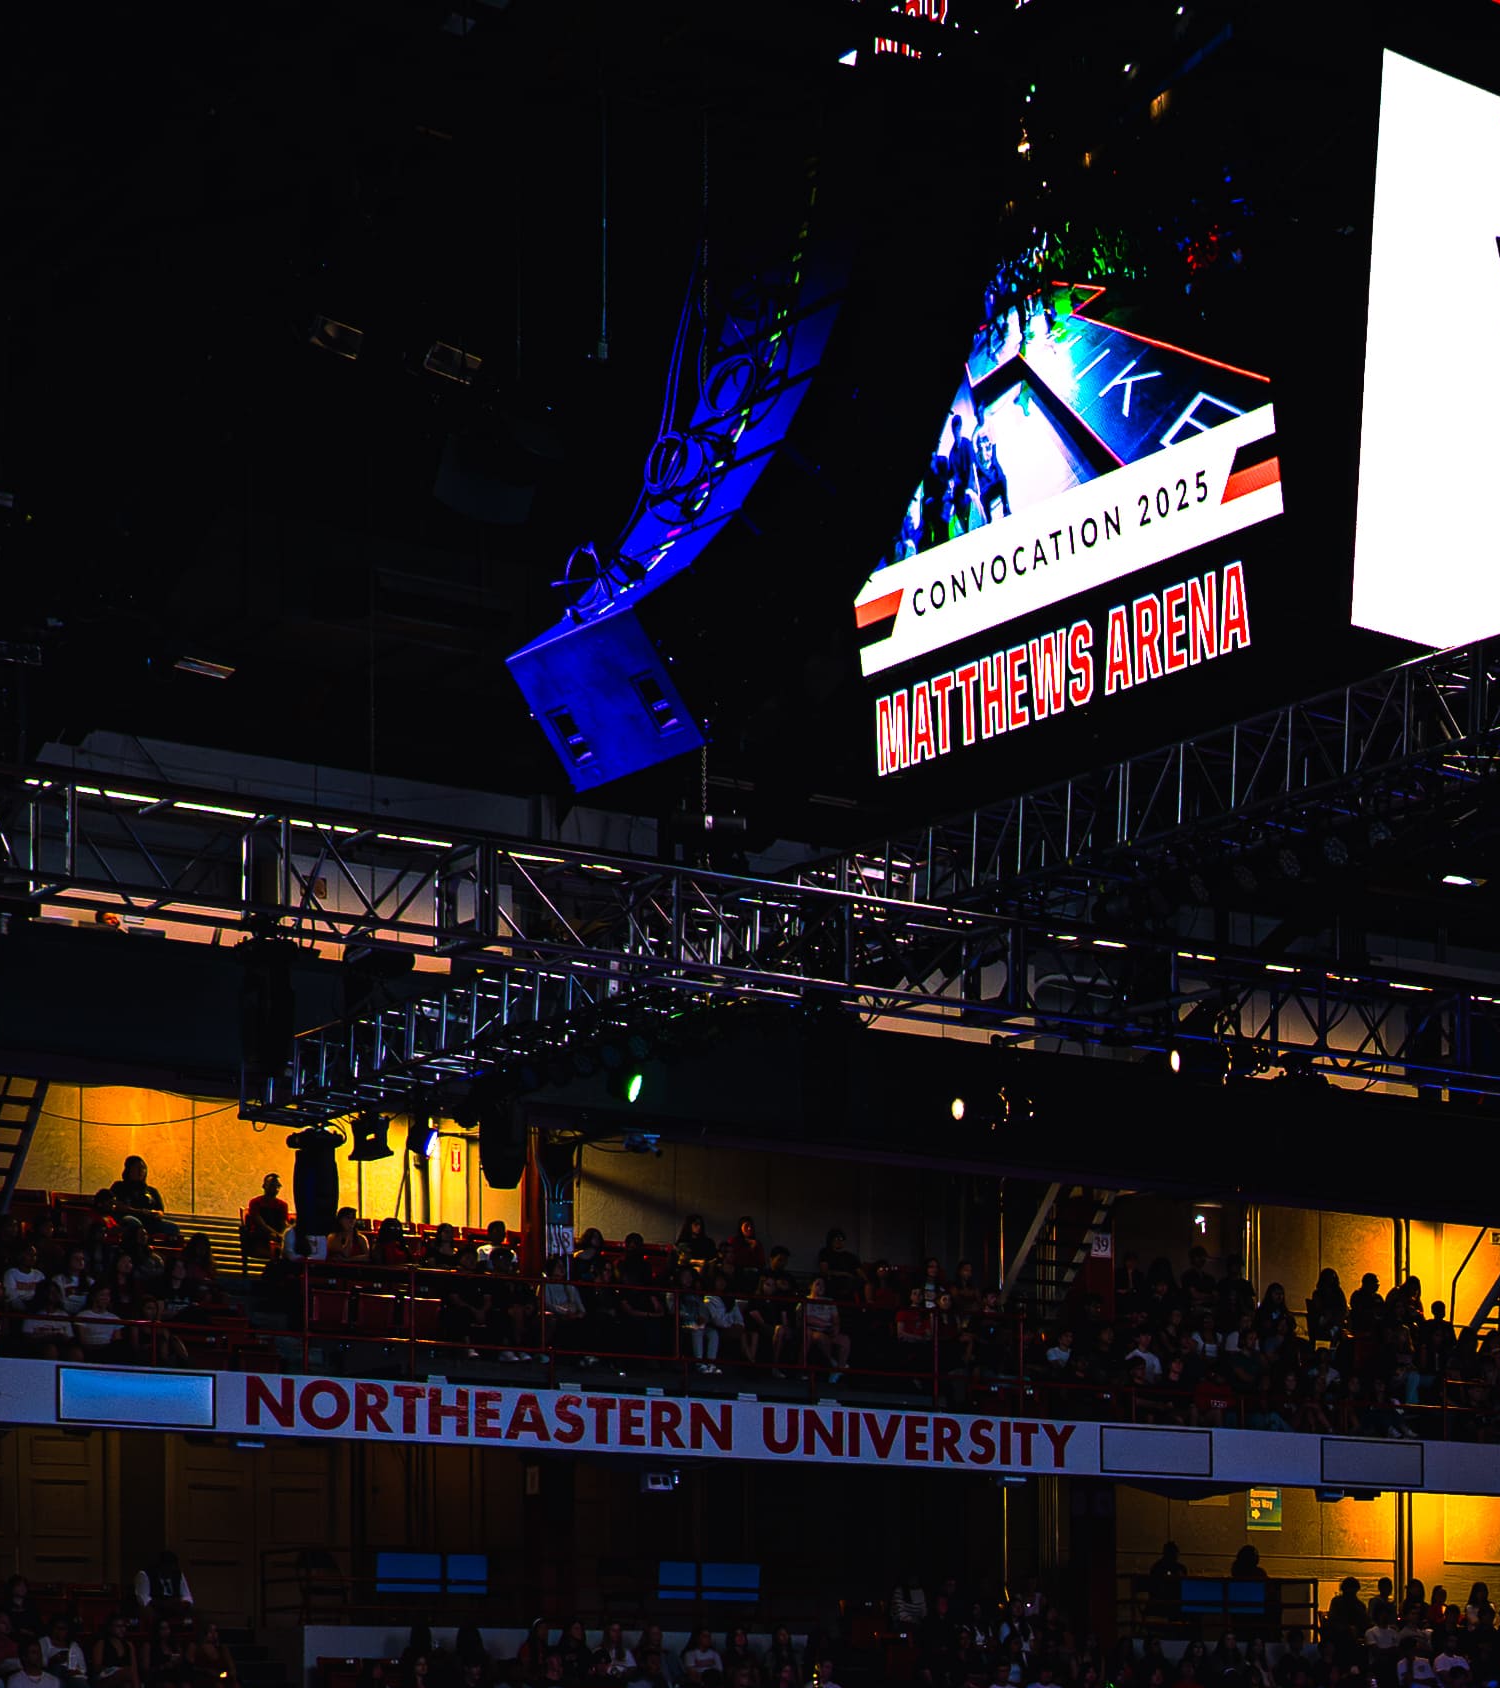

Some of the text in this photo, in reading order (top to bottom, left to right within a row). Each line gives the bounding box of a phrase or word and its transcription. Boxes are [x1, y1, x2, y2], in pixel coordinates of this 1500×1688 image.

[912, 470, 1208, 617] CONVOCATION 2025
[875, 560, 1252, 777] MATTHEWS ARENA
[1093, 1235, 1110, 1253] 39
[244, 1374, 1077, 1469] NORTHEASTERN UNIVERSITY
